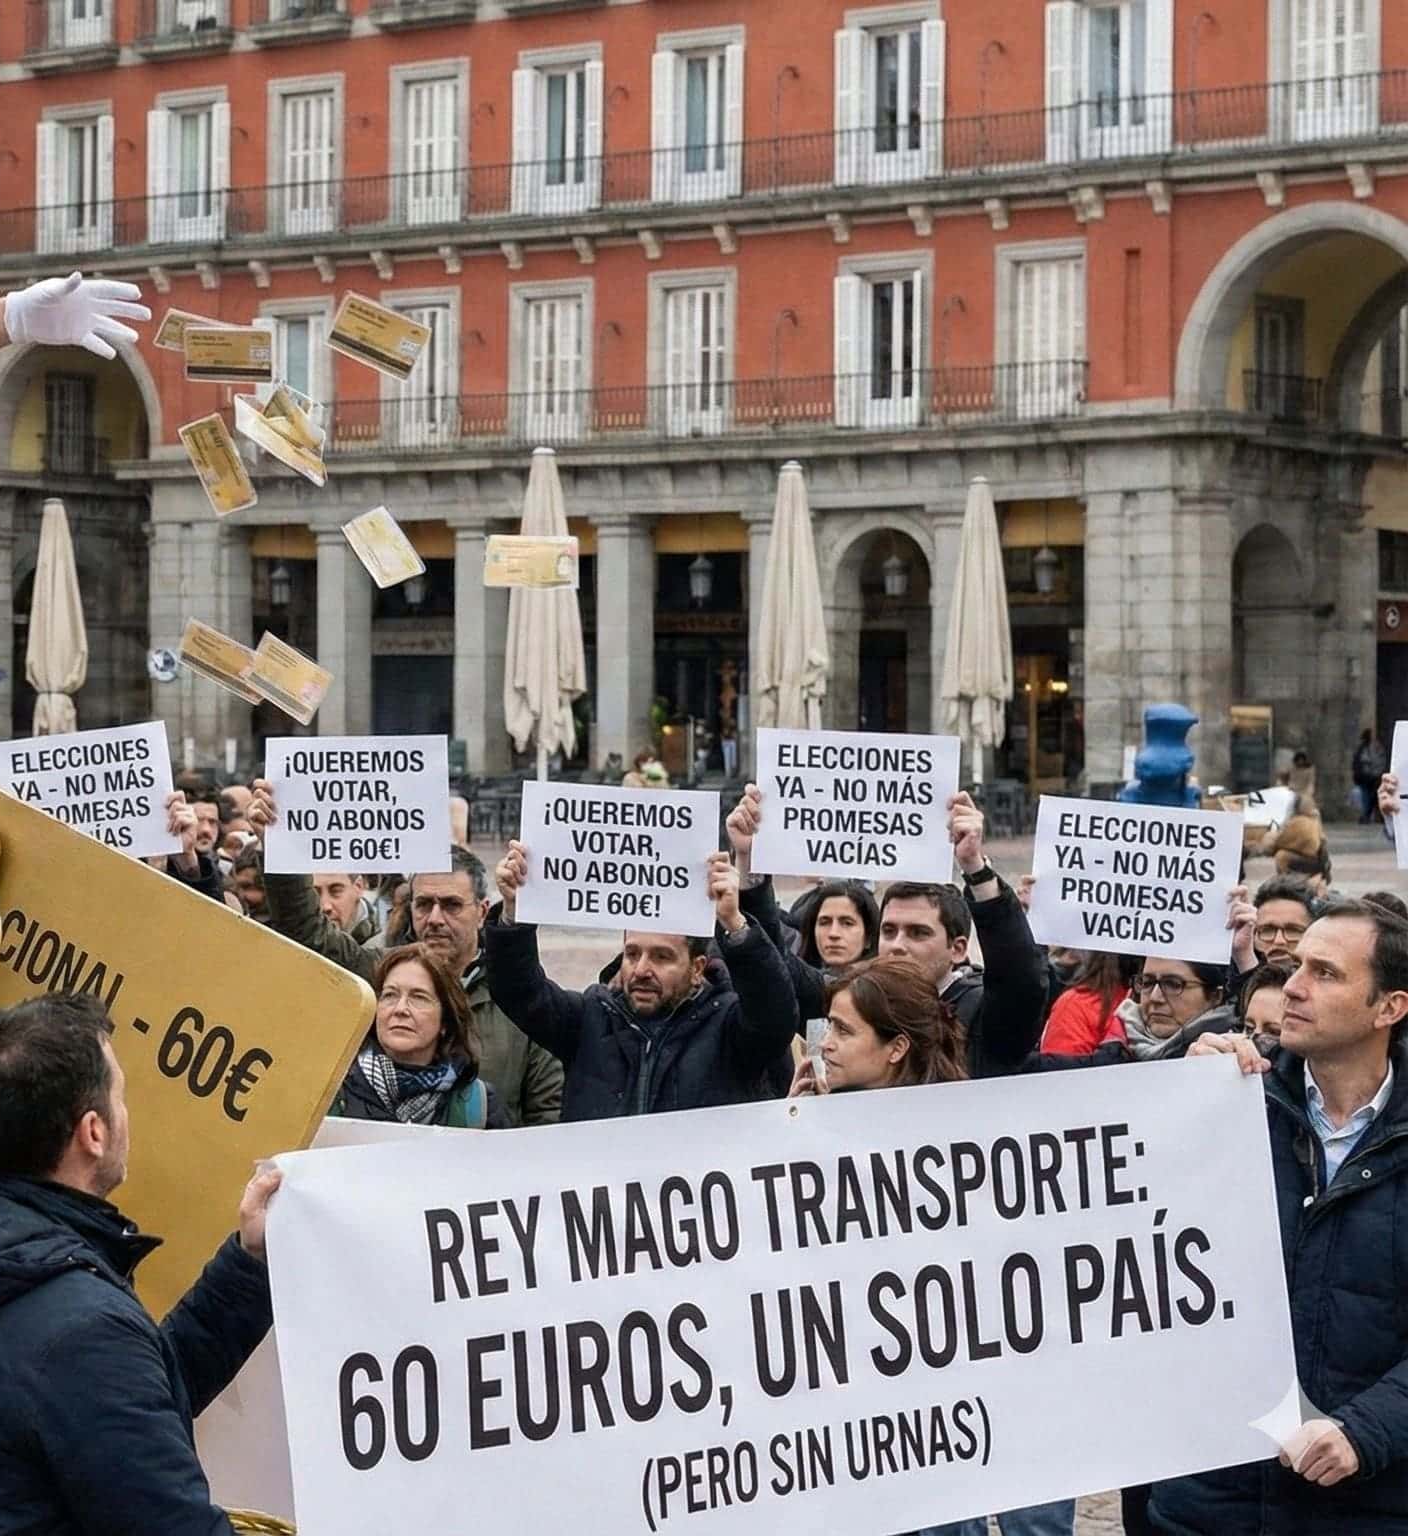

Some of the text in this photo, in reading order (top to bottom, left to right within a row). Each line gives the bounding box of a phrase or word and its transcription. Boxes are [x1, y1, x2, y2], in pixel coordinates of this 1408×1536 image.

[11, 738, 150, 774] ELECCIONES
[285, 749, 425, 779] ¡QUEREMOS
[777, 744, 932, 775] ELECCIONES
[12, 780, 42, 801] YA
[65, 774, 96, 797] NO
[104, 763, 155, 793] MÁS
[313, 780, 398, 806] VOTAR,
[775, 775, 806, 799] YA
[833, 778, 867, 802] NO
[877, 776, 933, 806] MÁS
[43, 796, 151, 825] OMESAS
[287, 809, 425, 832] NO ABONOS
[544, 797, 692, 830] ¡QUEREMOS
[783, 807, 923, 836] PROMESAS
[572, 830, 661, 862] VOTAR,
[1058, 812, 1217, 850] ELECCIONES
[311, 837, 401, 861] DE 60€!
[806, 835, 898, 867] VACÍAS
[1055, 845, 1085, 870] YA
[1113, 851, 1148, 877] NO
[1157, 852, 1215, 883] MÁS
[543, 857, 689, 889] NO ABONOS
[567, 888, 660, 918] DE 60€!
[1061, 877, 1204, 914] PROMESAS
[1082, 911, 1175, 944] VACÍAS
[0, 909, 124, 1035] CIONAL
[157, 1006, 273, 1122] 60€
[424, 1123, 1148, 1303] REY MAGO TRANSPORTE:
[339, 1208, 1234, 1472] 60 EUROS, UN SOLO PAÍS.
[642, 1396, 992, 1533] (PERO SIN URNAS)
